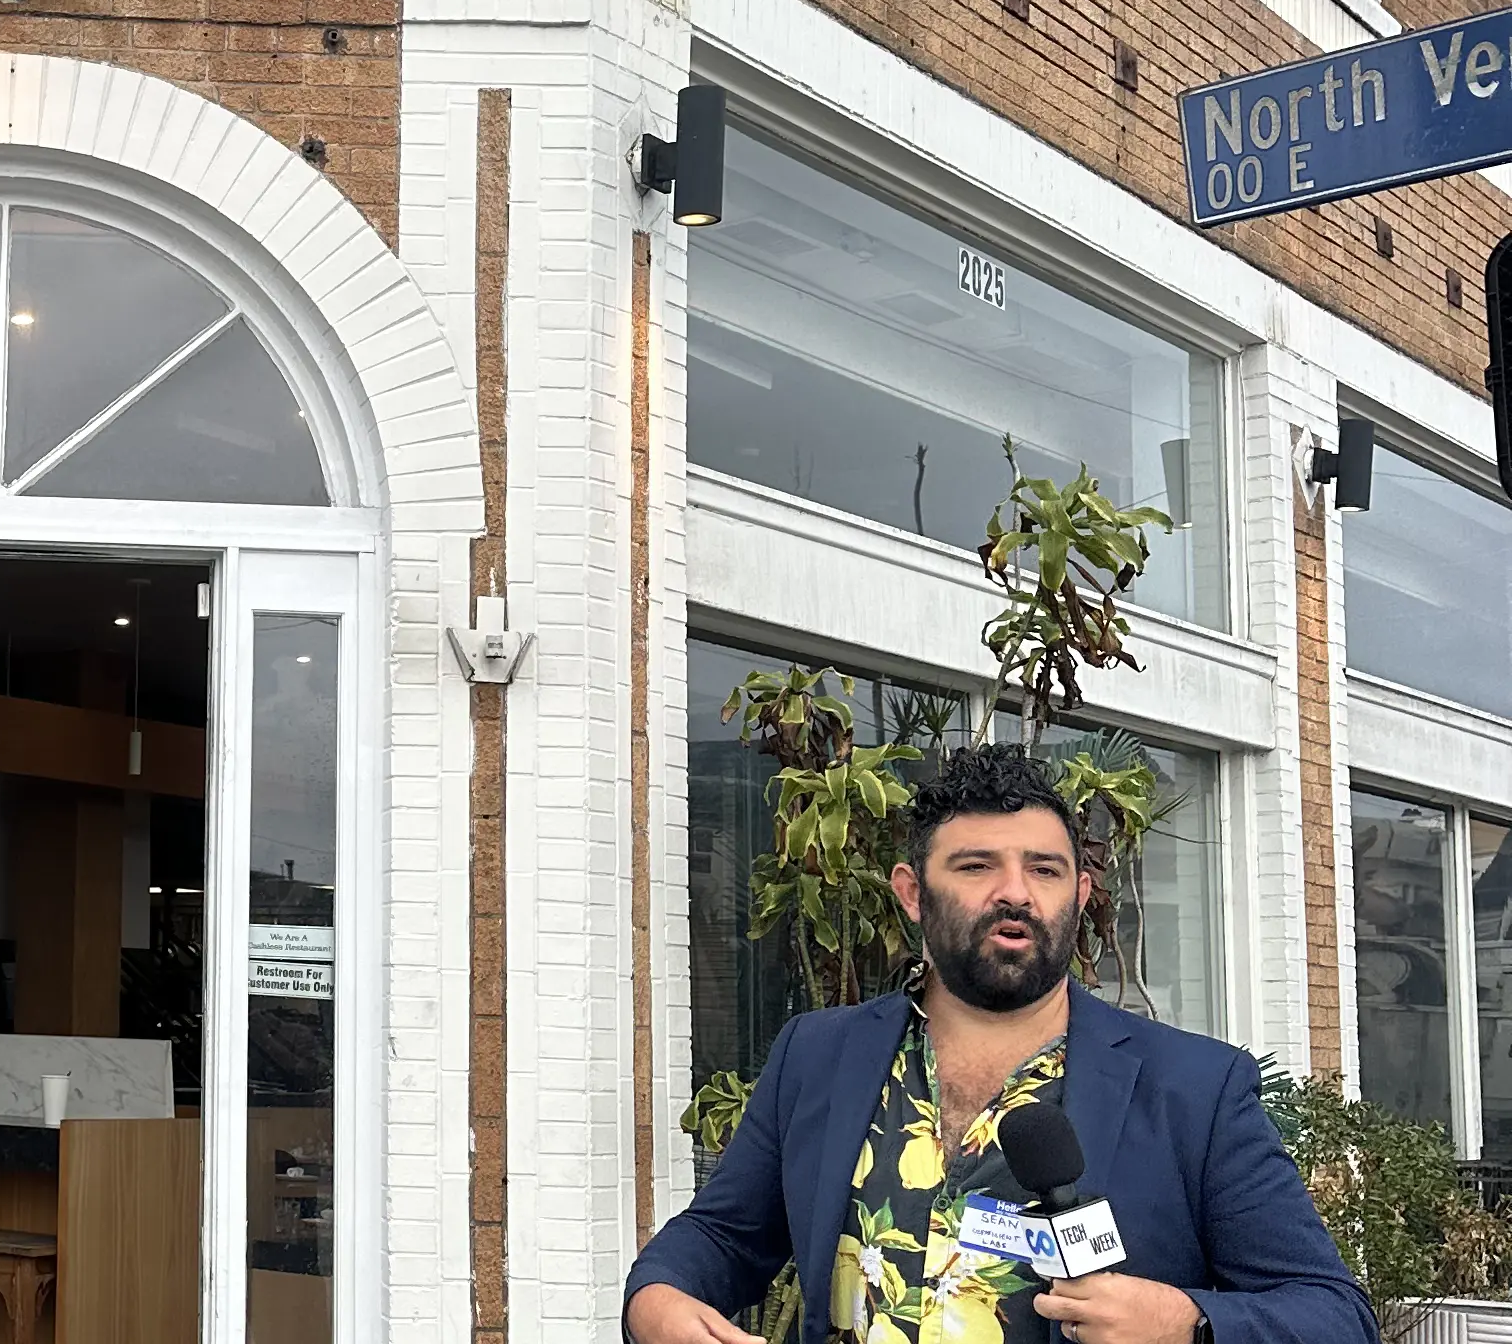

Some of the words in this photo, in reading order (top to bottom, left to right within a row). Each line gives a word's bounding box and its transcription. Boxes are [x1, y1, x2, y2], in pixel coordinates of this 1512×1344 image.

[1202, 58, 1387, 162] North
[1419, 31, 1512, 107] Ve
[1207, 155, 1263, 210] 00
[1289, 142, 1316, 193] E
[960, 249, 1004, 308] 2025
[269, 932, 283, 941] We
[284, 933, 300, 942] Are
[301, 934, 308, 942] A
[285, 943, 332, 952] Restaurant
[257, 965, 303, 979] Restroom
[306, 968, 323, 980] For
[292, 980, 311, 992] Use
[313, 981, 335, 995] Only
[980, 1212, 1020, 1230] SEAN
[1059, 1222, 1088, 1247] TECH
[1088, 1231, 1119, 1255] WEEK
